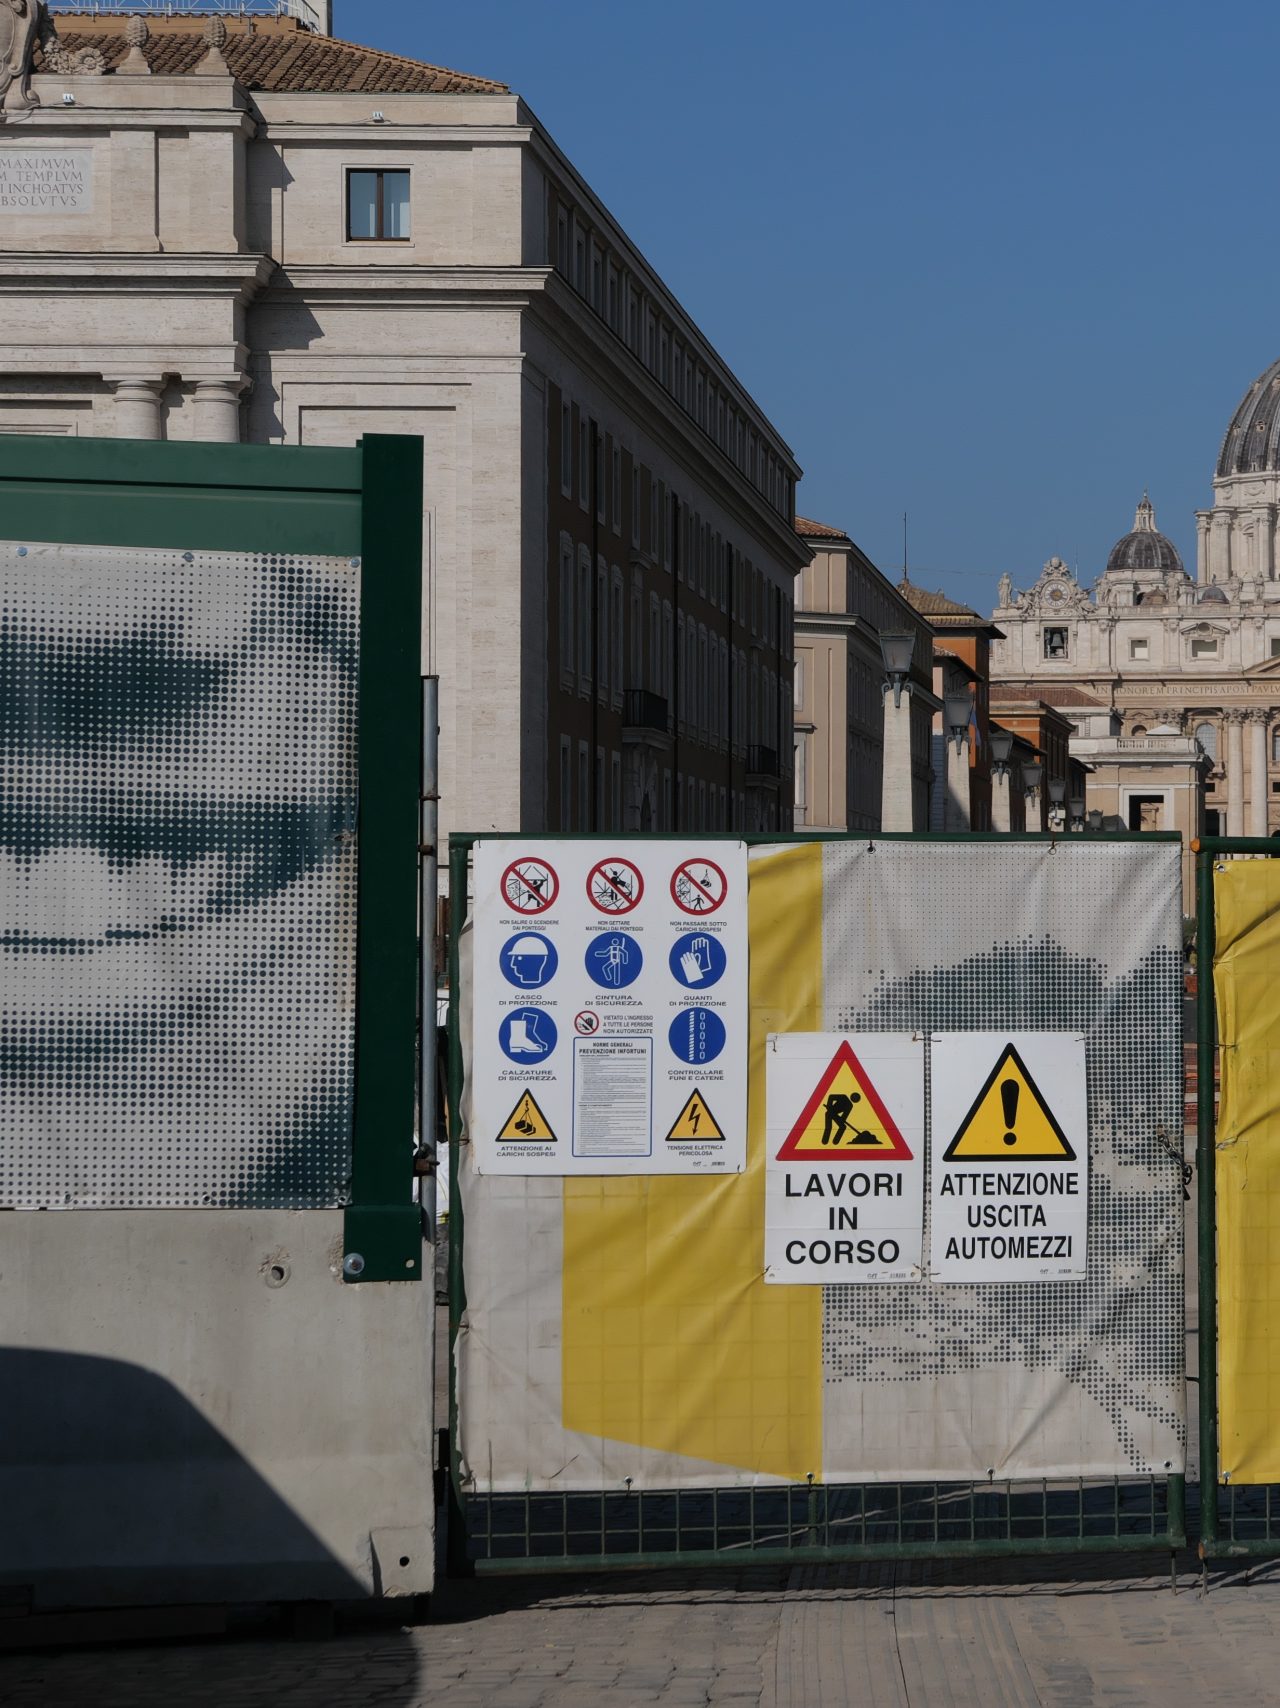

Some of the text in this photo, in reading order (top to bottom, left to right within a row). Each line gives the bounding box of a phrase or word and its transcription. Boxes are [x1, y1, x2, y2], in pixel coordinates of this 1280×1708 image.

[16, 171, 83, 181] TEMPLVM
[0, 196, 77, 207] BSOLVTVS
[785, 1173, 902, 1197] LAVORI
[941, 1173, 1079, 1196] ATTENZIONE
[829, 1207, 858, 1230] IN
[967, 1205, 1046, 1227] USCITA
[785, 1240, 899, 1264] CORSO
[945, 1236, 1072, 1259] AUTOMEZZI
